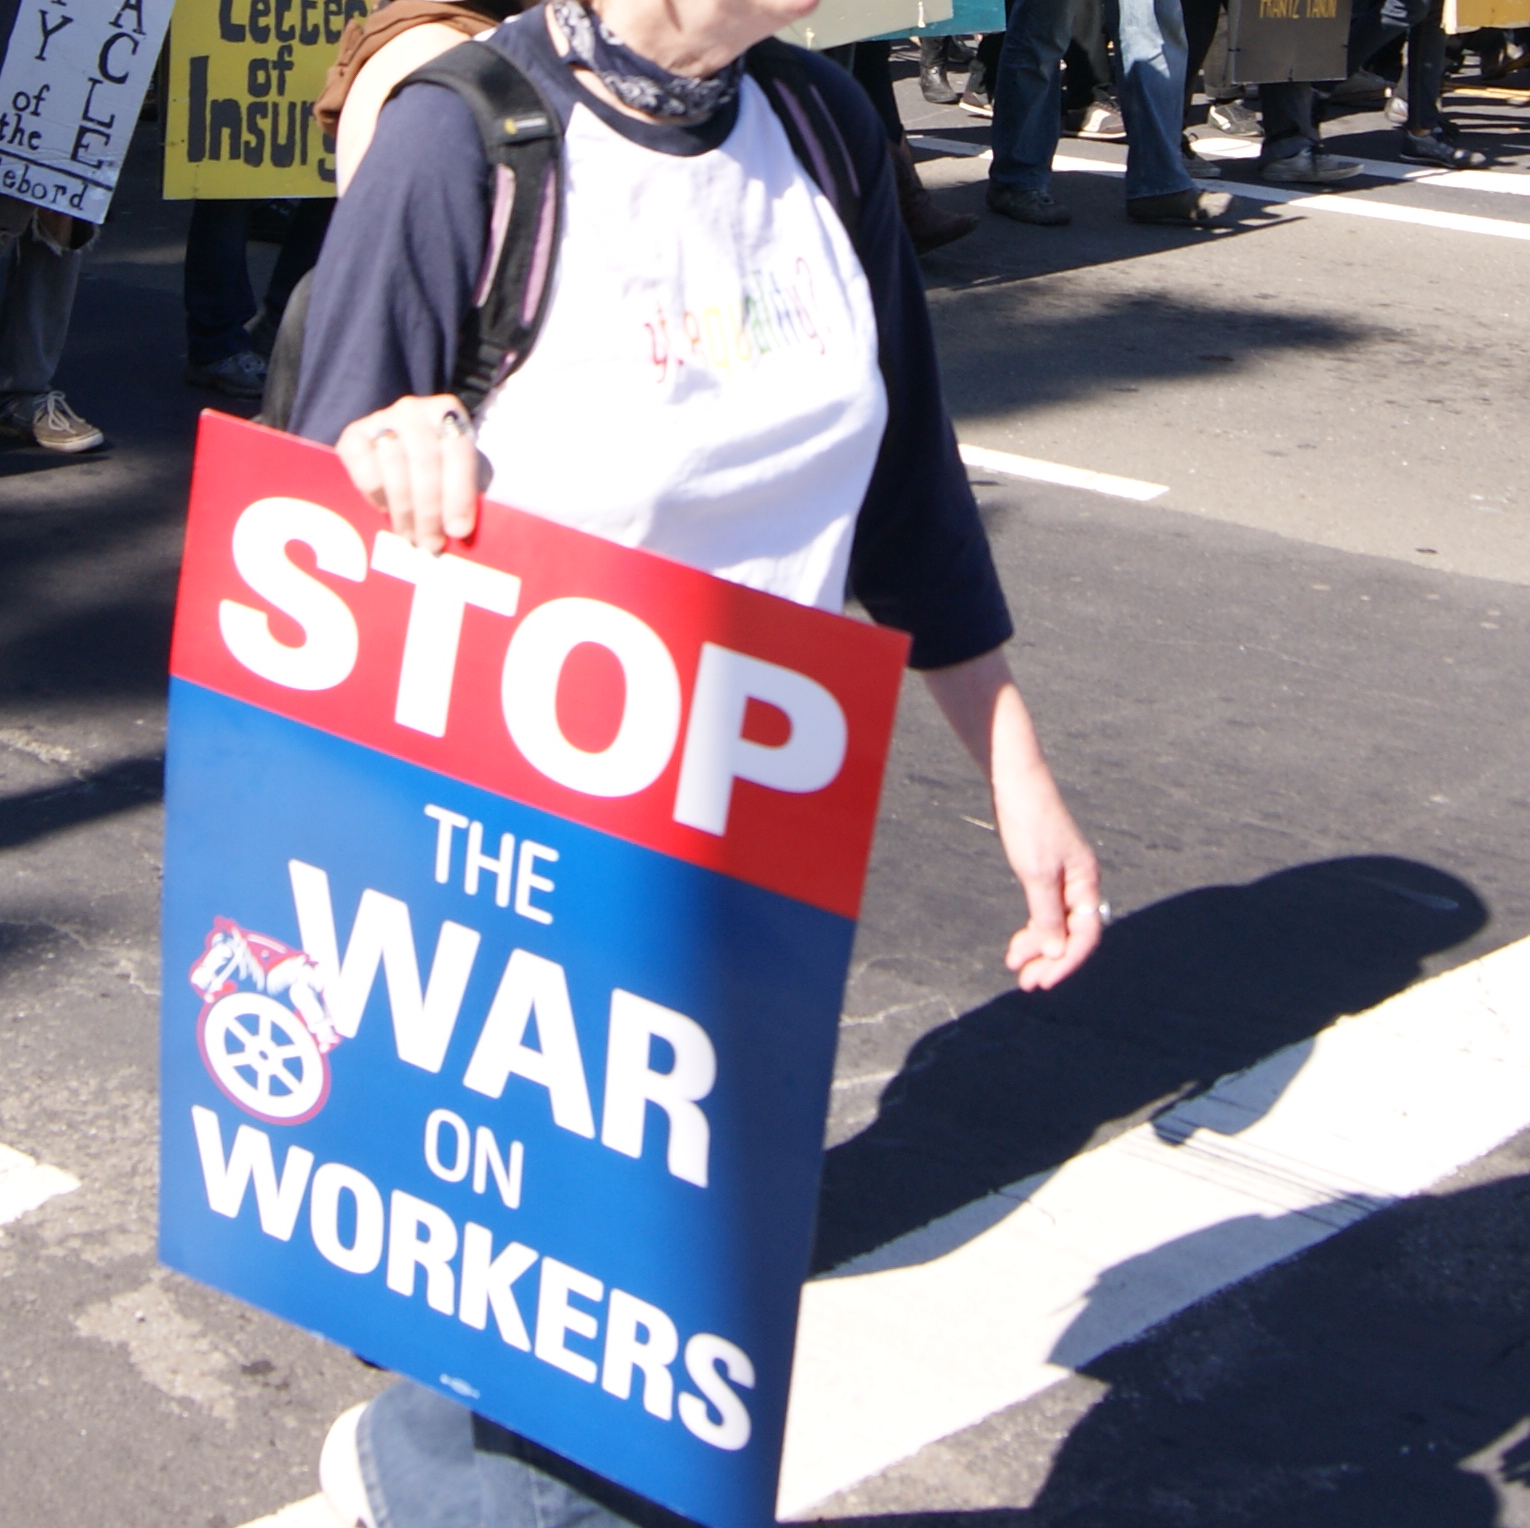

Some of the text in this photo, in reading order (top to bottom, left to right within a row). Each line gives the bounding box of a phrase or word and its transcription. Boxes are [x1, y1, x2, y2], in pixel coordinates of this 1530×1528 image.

[11, 84, 50, 118] of
[247, 44, 294, 98] of
[218, 497, 848, 837] STOP
[424, 803, 559, 925] THE
[288, 860, 716, 1188] WAR
[423, 1108, 523, 1209] ON
[191, 1104, 755, 1451] WORKERS
